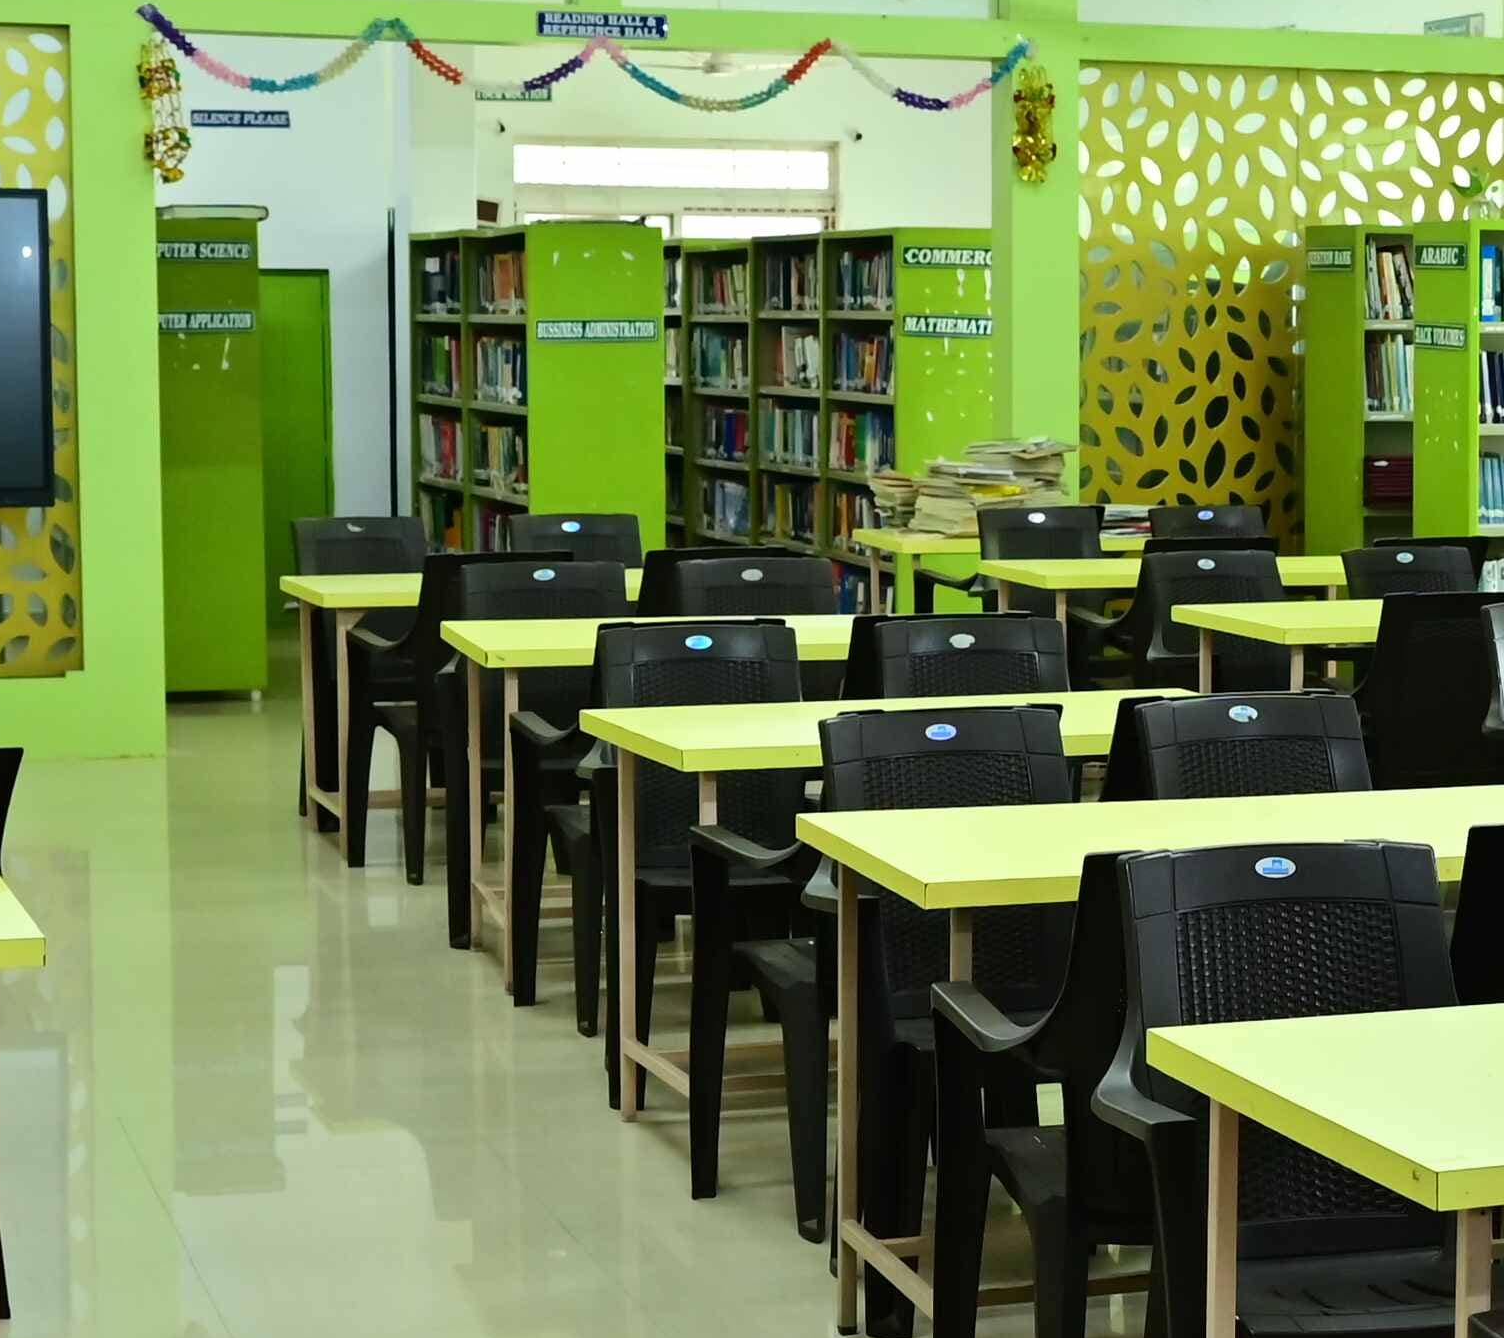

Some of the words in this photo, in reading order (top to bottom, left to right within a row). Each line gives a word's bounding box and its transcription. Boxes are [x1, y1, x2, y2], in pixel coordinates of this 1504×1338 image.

[545, 12, 604, 25] READING
[608, 14, 644, 26] HALL
[542, 24, 622, 37] REFERENCE
[624, 27, 660, 38] HALL
[192, 112, 241, 124] SILENCE
[243, 113, 289, 125] PLEASE
[199, 244, 250, 259] SCIENCE
[1419, 246, 1459, 265] ARABIC
[188, 314, 251, 329] APPLICATION
